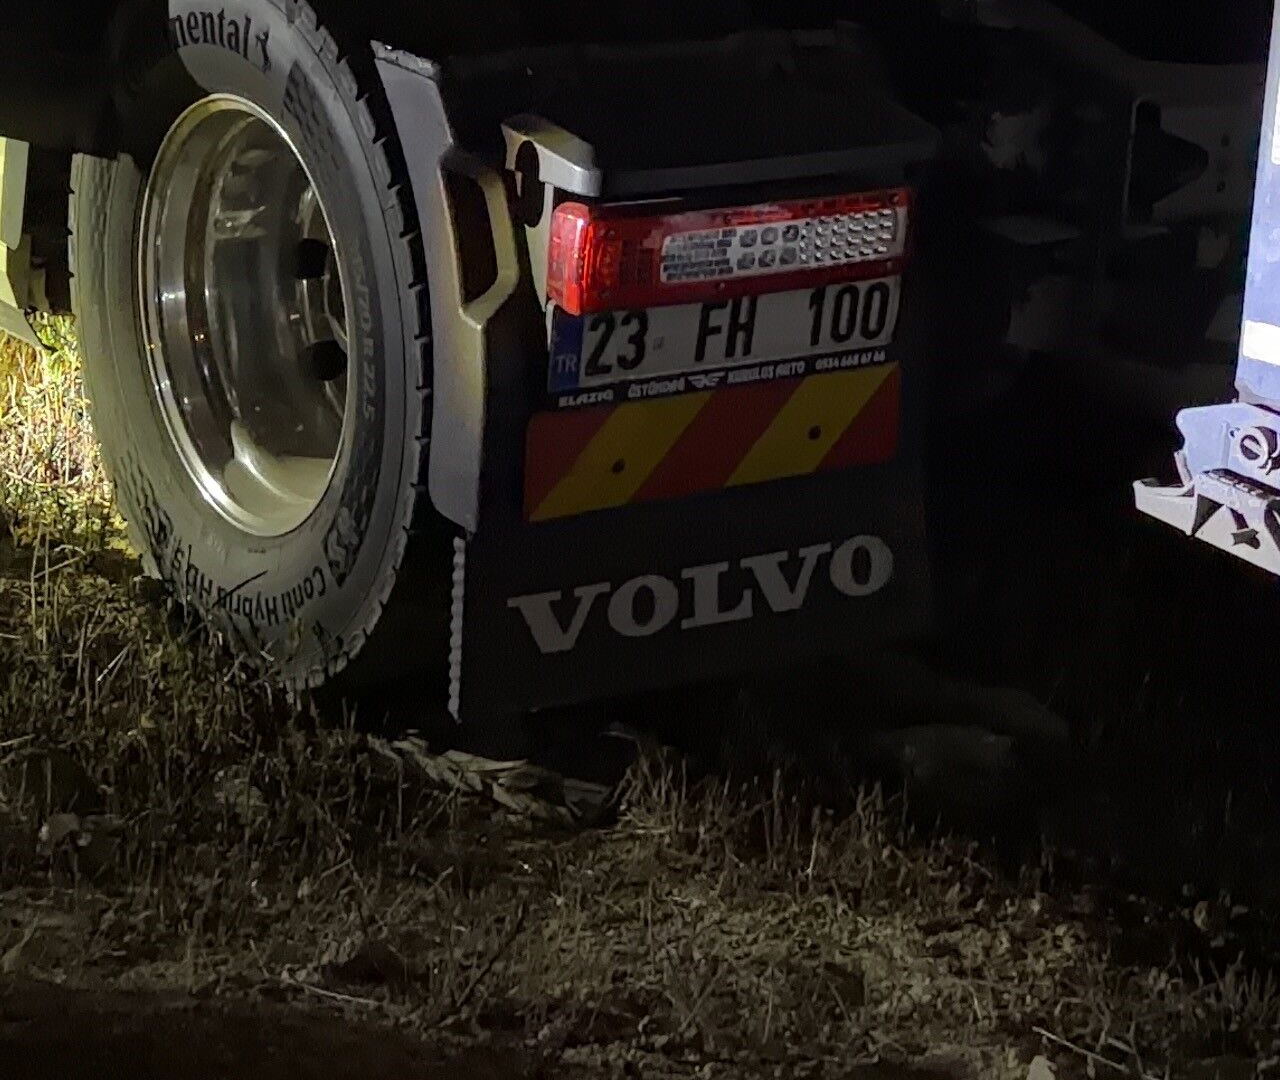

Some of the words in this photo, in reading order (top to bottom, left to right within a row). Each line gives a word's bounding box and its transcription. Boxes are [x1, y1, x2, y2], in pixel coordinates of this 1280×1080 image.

[555, 354, 578, 374] TR
[584, 309, 649, 376] 23
[695, 296, 758, 362] FH
[808, 281, 890, 347] 100
[280, 566, 326, 619] Conti
[506, 533, 896, 655] VOLVO
